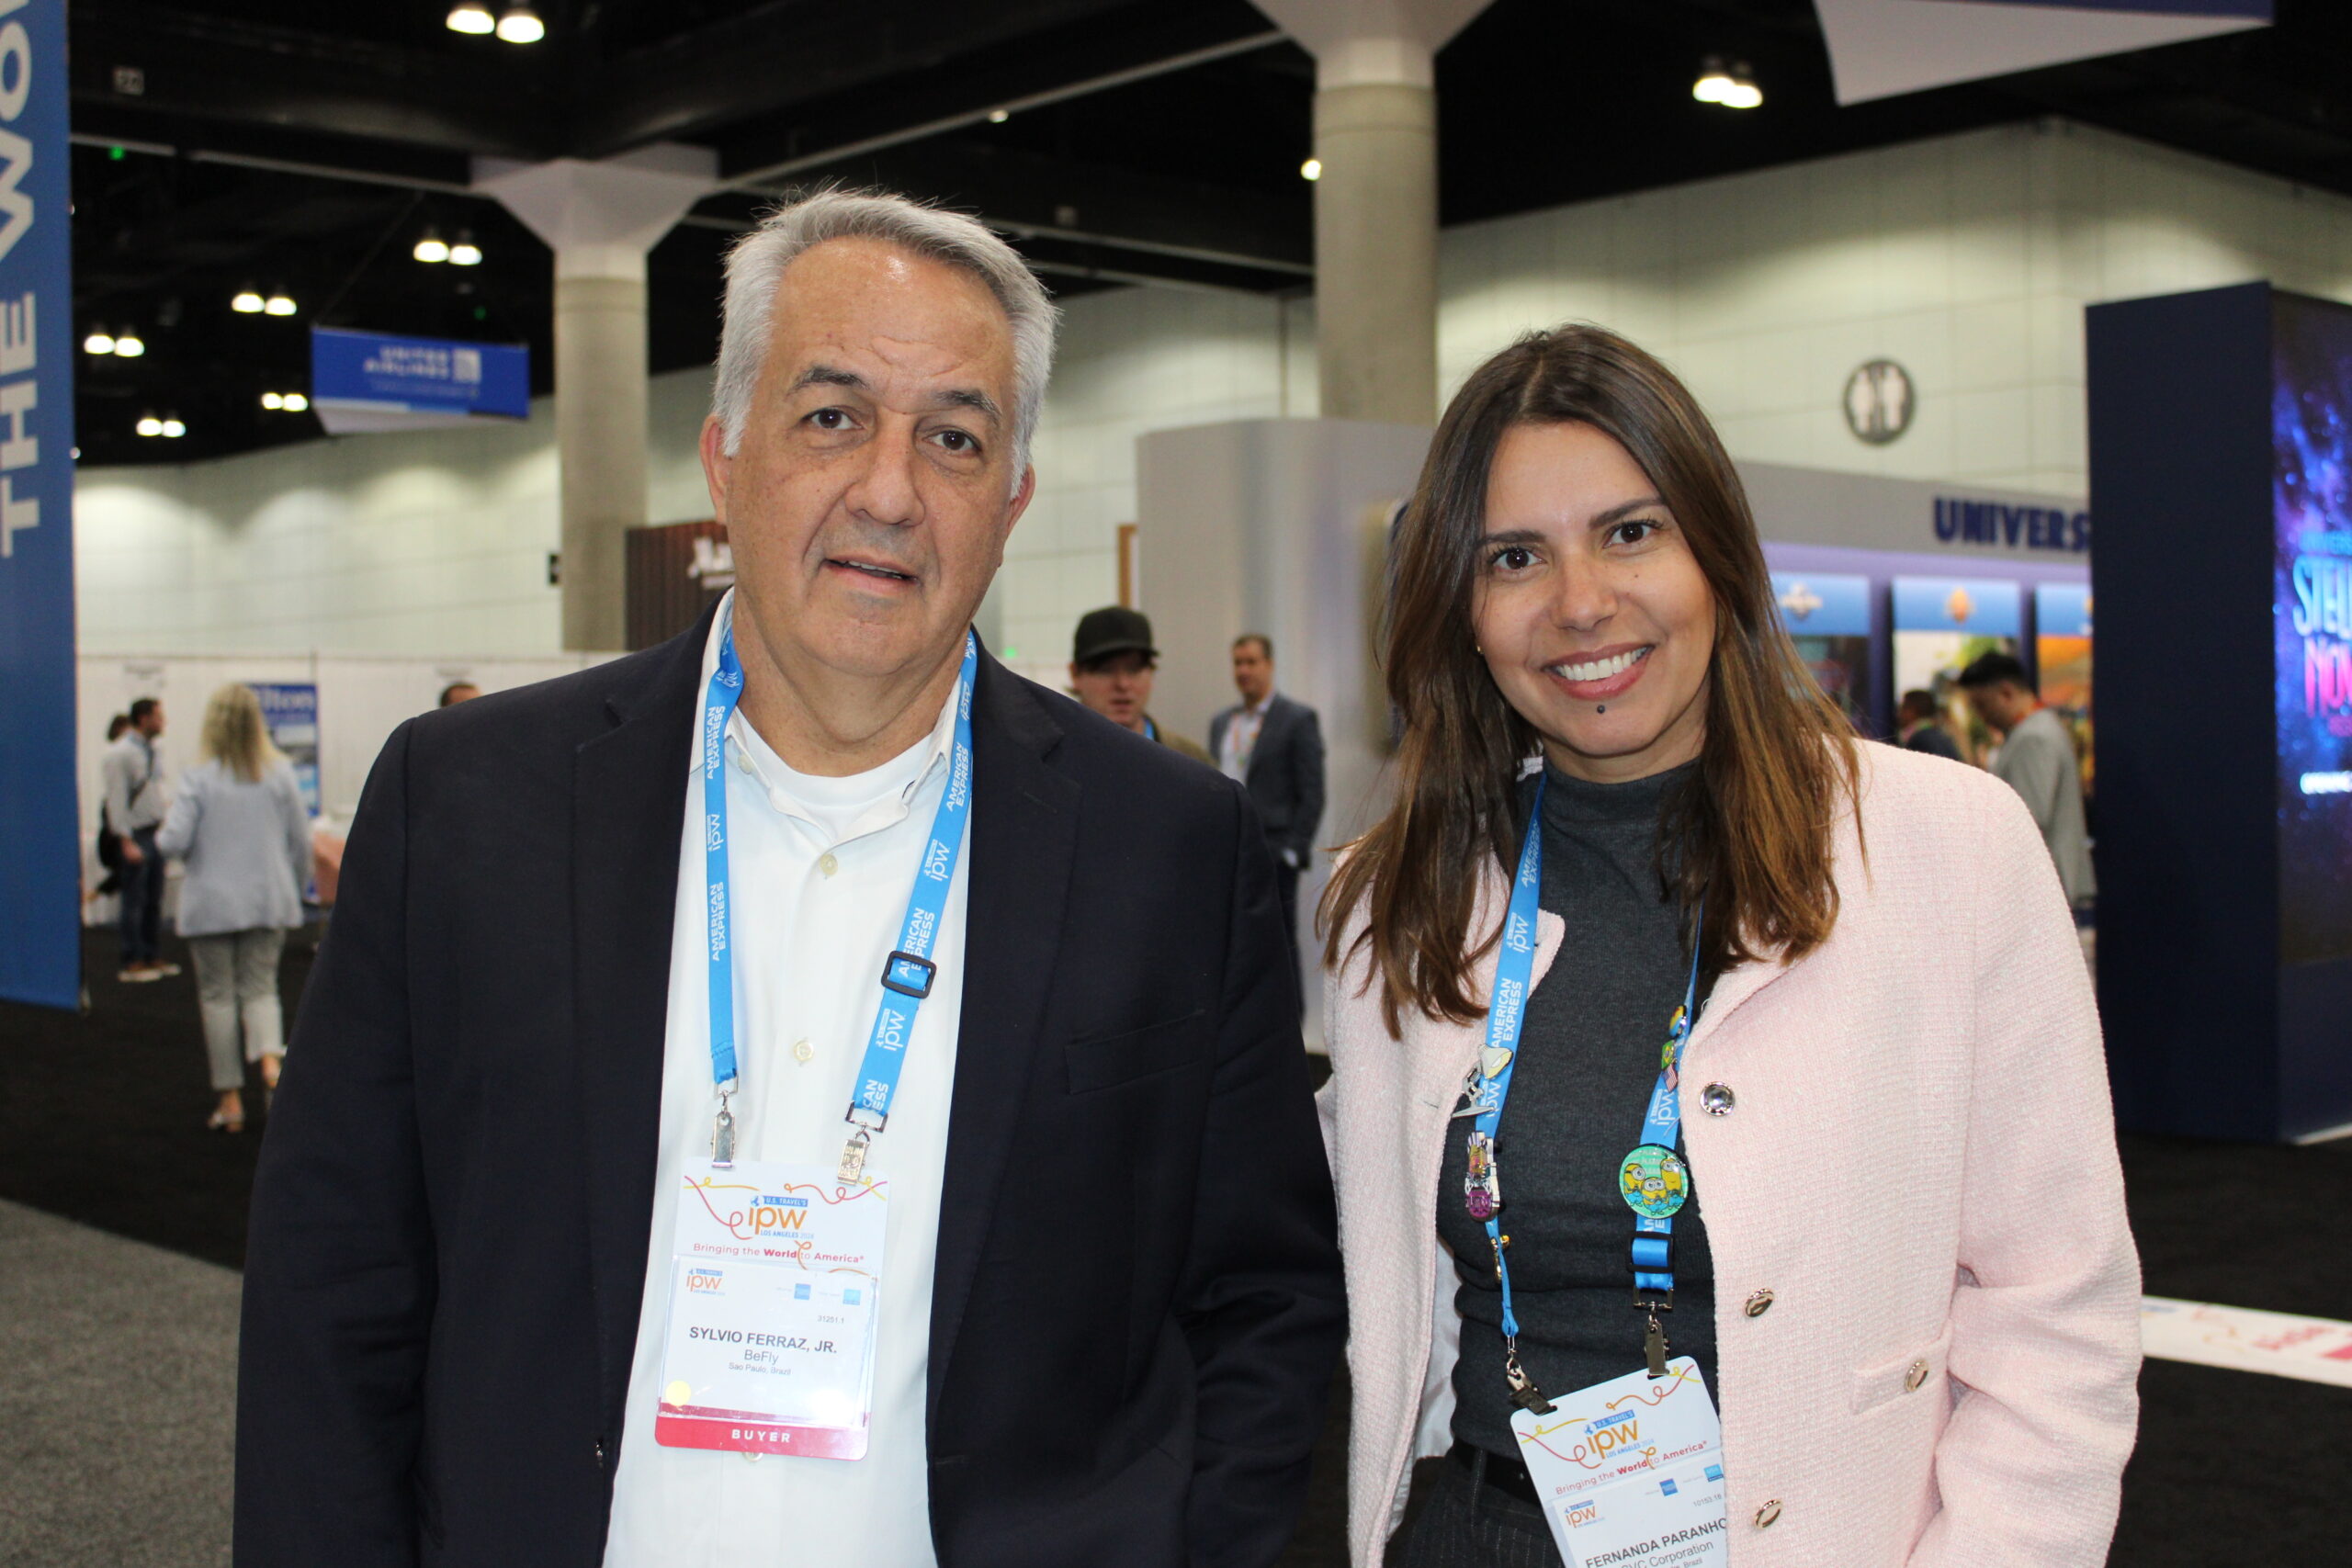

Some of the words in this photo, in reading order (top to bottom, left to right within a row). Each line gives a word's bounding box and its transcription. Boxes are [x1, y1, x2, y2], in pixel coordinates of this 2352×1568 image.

[0, 0, 35, 262] WO
[0, 291, 40, 558] THE
[707, 706, 717, 780] AMERICAN
[712, 705, 726, 769] EXPRESS
[946, 741, 963, 812] AMERICAN
[956, 748, 969, 807] EXPRESS
[1521, 818, 1538, 888] AMERICAN
[710, 883, 720, 962] AMERICAN
[717, 881, 727, 951] EXPRESS
[910, 911, 935, 971] EPRESS
[1491, 976, 1512, 1048] AMERICAN
[1502, 980, 1522, 1042] EXPRESS
[748, 1206, 808, 1235] ipw
[773, 1230, 798, 1238] ANGELES
[693, 1243, 739, 1257] Bringing
[742, 1246, 760, 1257] the
[763, 1248, 797, 1258] World
[689, 1325, 742, 1343] SYLVIO
[746, 1332, 809, 1353] FERRAZ,
[814, 1340, 837, 1354] JR.
[729, 1362, 743, 1371] Sao
[745, 1363, 769, 1374] Paulo,
[770, 1366, 791, 1376] Brazil
[744, 1348, 779, 1365] BeFly
[731, 1428, 790, 1443] BUYER
[1587, 1419, 1638, 1460] ipw
[1555, 1477, 1598, 1495] Bringing
[1599, 1470, 1615, 1482] the
[1617, 1459, 1648, 1475] World
[1585, 1540, 1660, 1568] FERNANDA
[1649, 1540, 1714, 1565] Corporation
